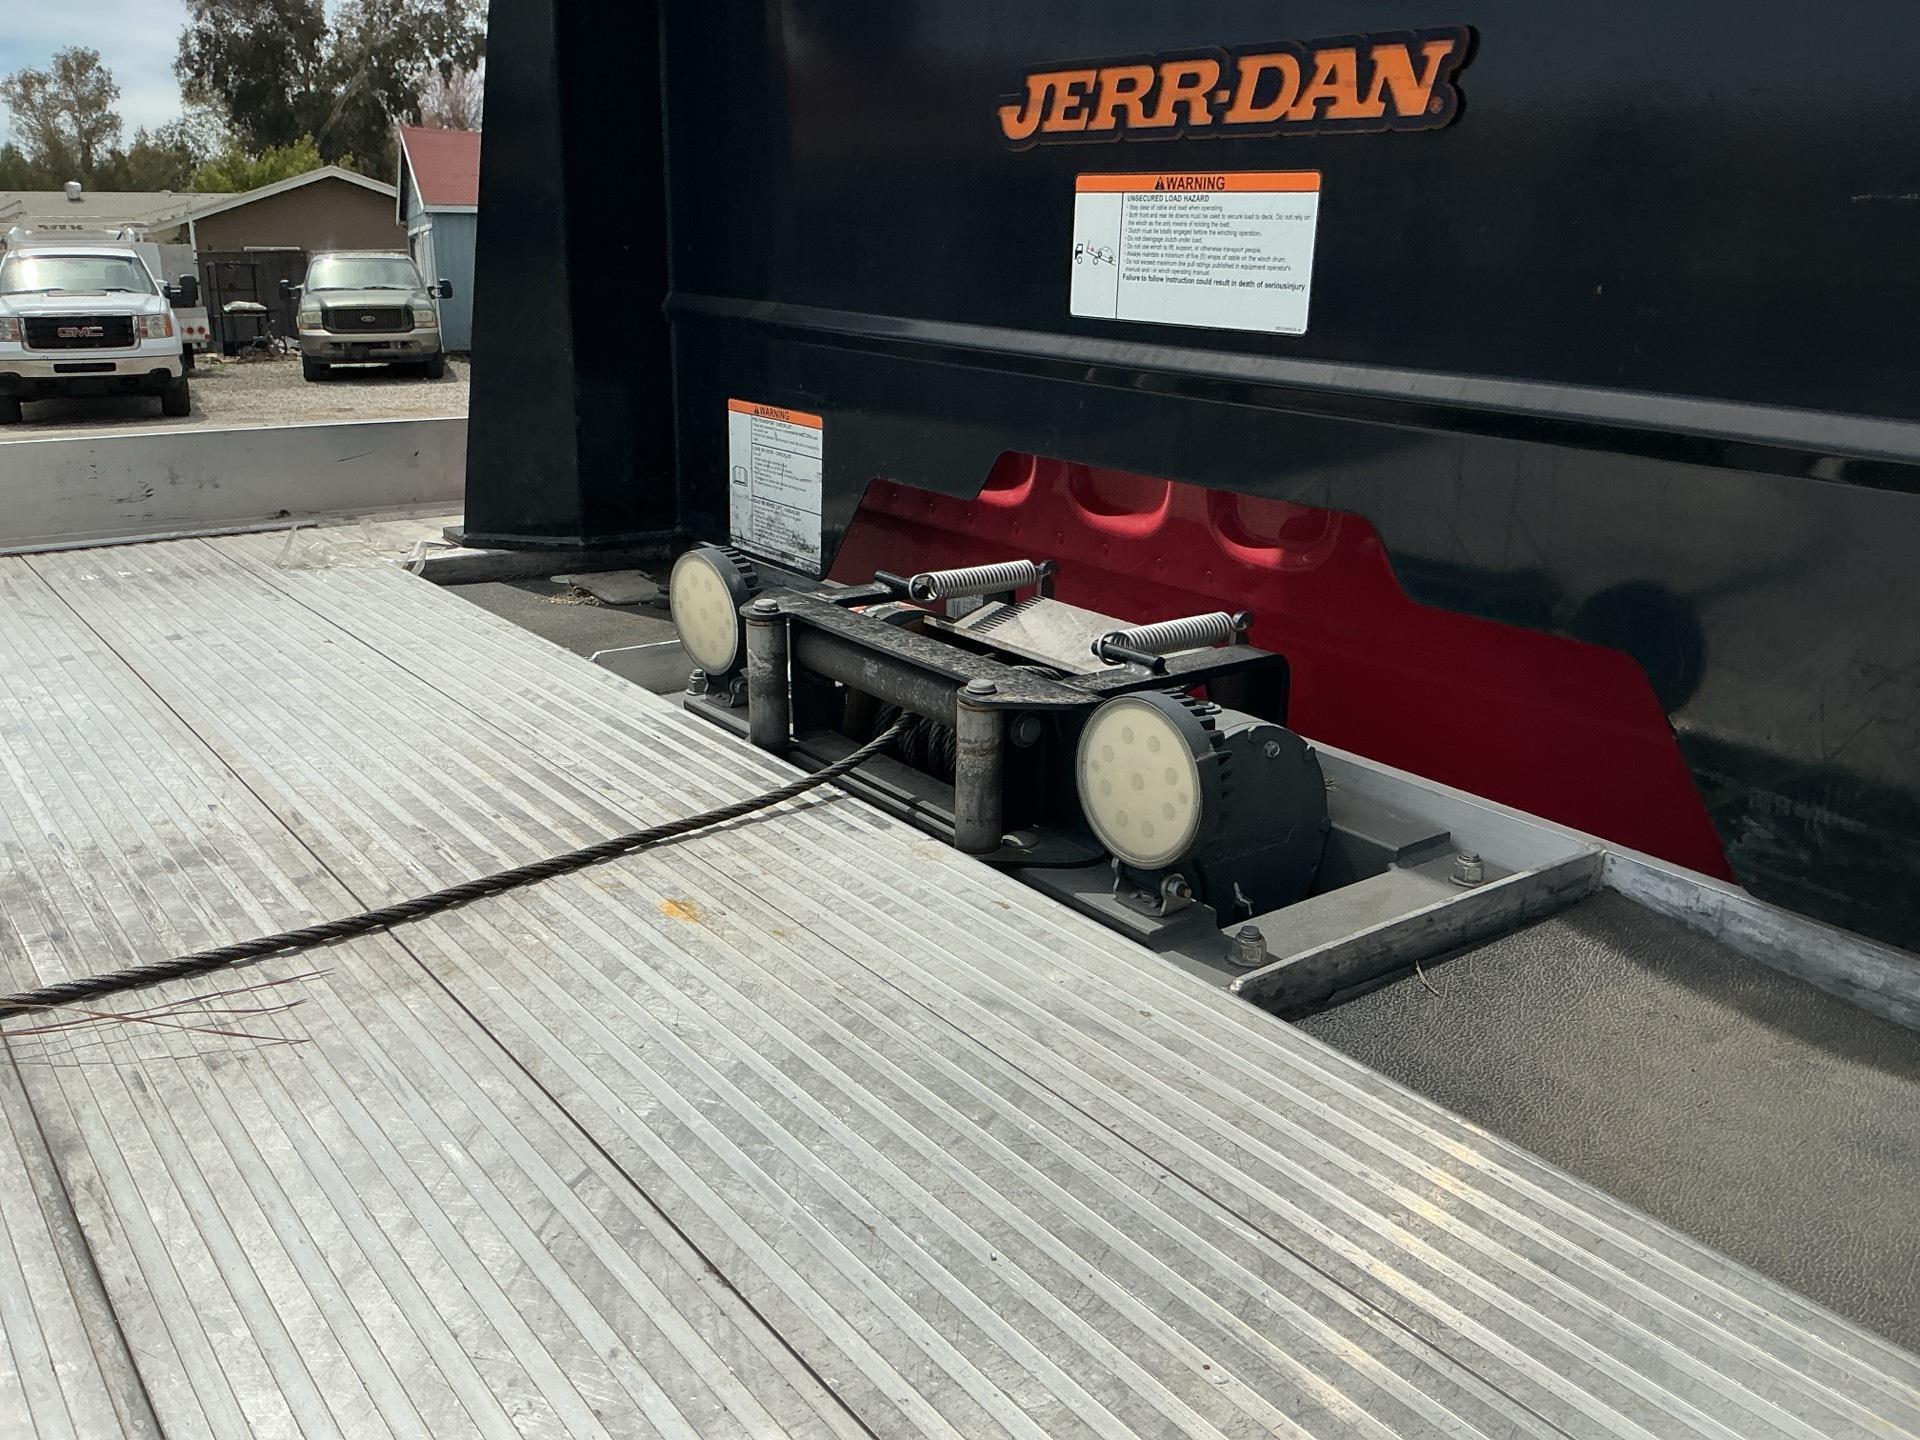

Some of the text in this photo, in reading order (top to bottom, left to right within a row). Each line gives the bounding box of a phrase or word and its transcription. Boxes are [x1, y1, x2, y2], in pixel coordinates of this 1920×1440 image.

[997, 39, 1456, 140] JERR-DAN
[1166, 176, 1225, 191] WARNING
[1122, 273, 1140, 281] Failure
[1148, 274, 1164, 282] follow
[1166, 276, 1194, 284] instruction
[1196, 278, 1212, 286] could
[1264, 282, 1306, 292] seriousinjury
[57, 326, 104, 338] GMC
[760, 406, 790, 421] WARNING
